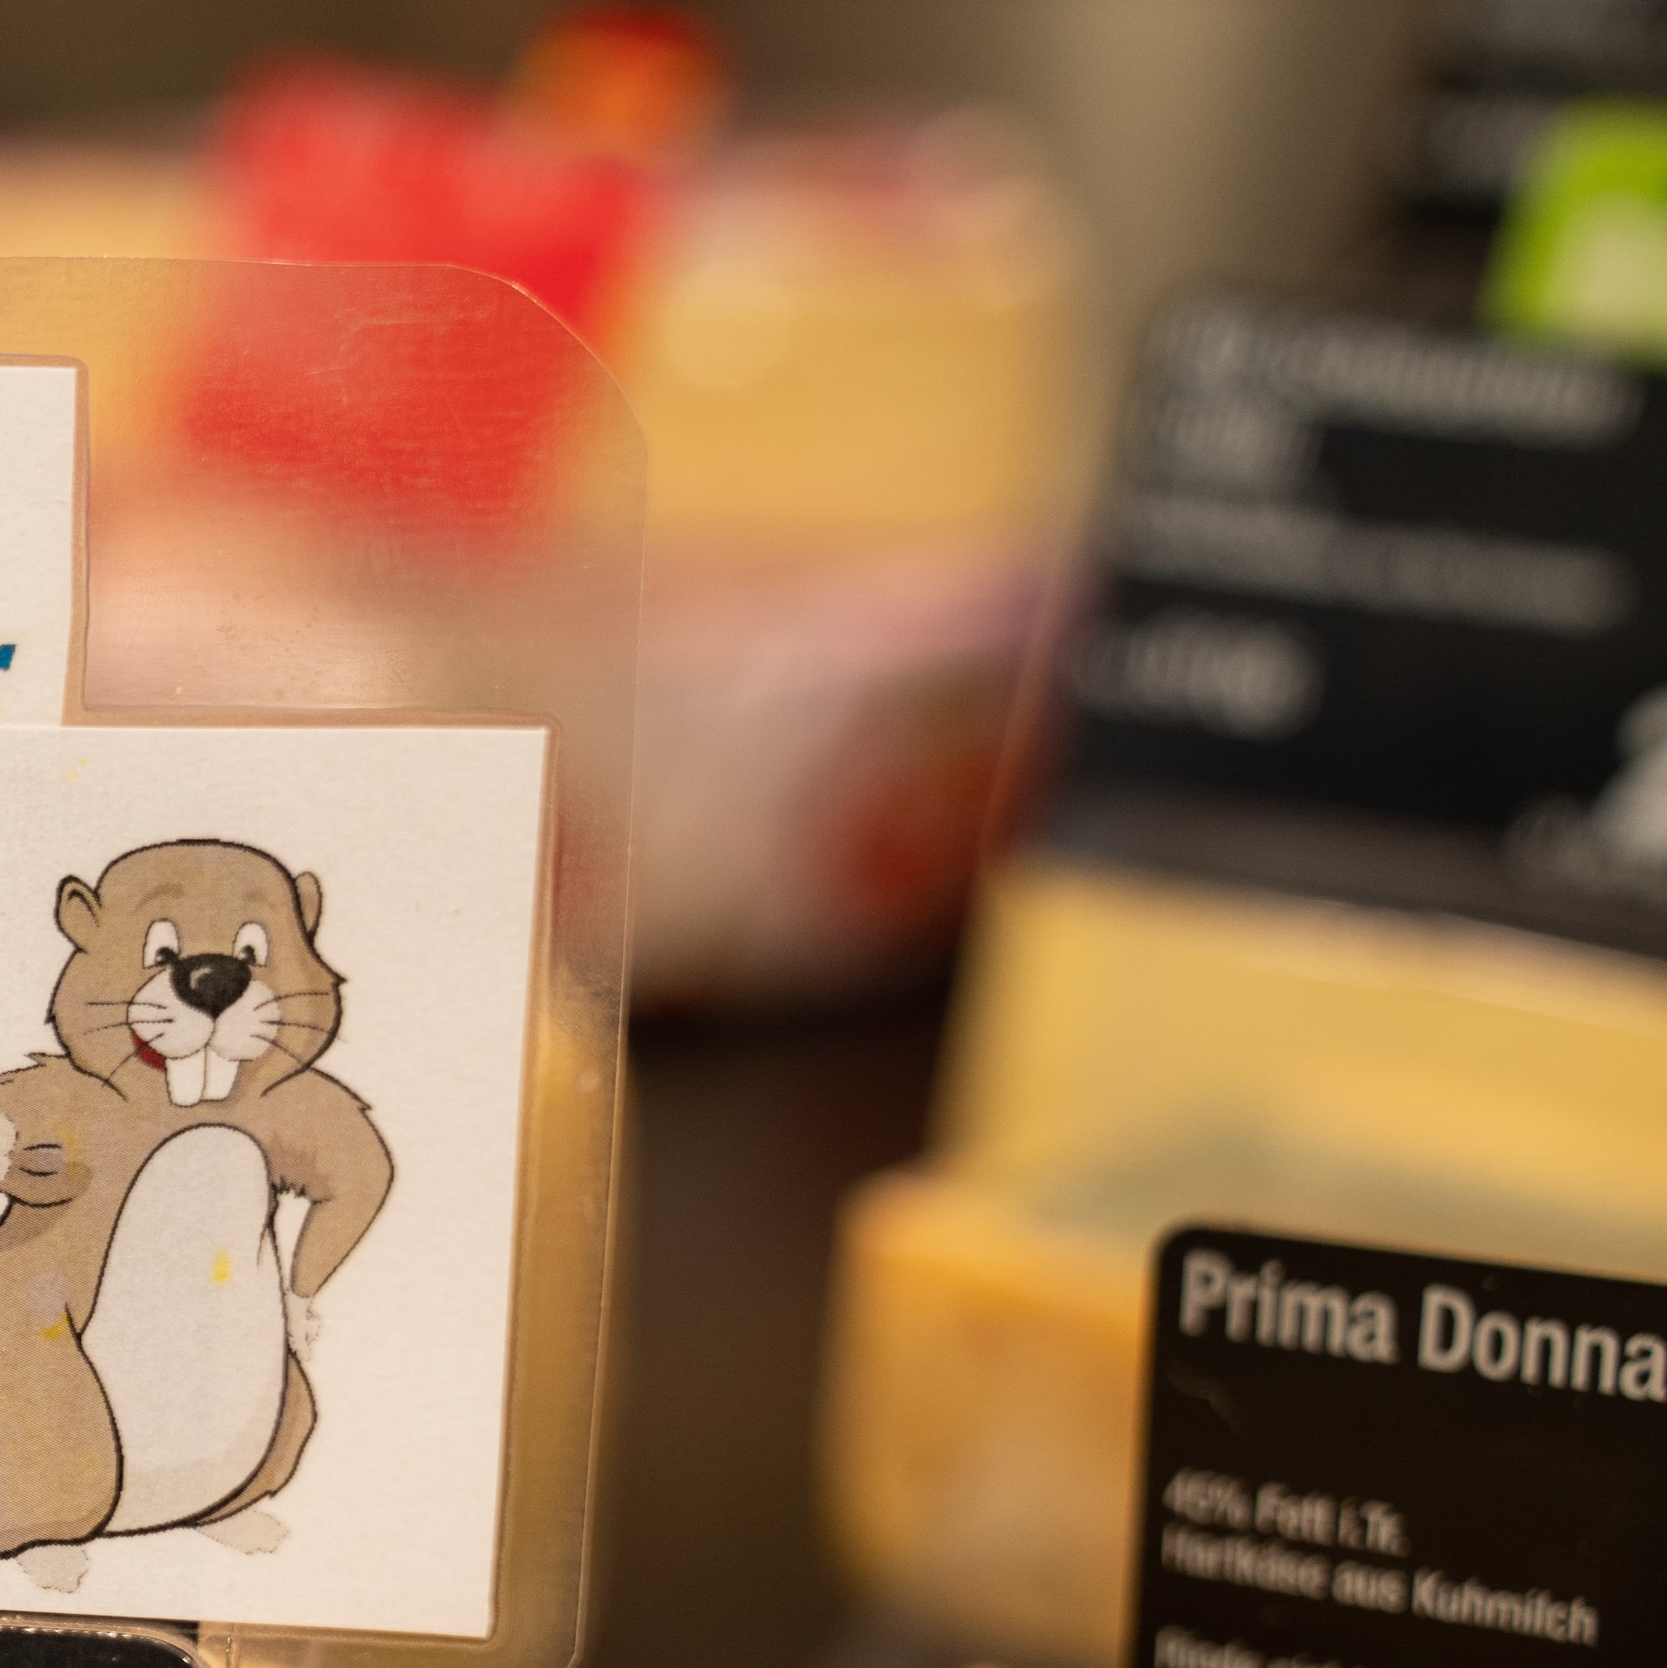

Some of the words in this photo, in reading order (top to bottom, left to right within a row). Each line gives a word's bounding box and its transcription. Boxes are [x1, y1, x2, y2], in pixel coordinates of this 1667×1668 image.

[1178, 1246, 1400, 1366] Prima
[1416, 1281, 1667, 1404] Donna
[1255, 1480, 1336, 1547] Fett
[1331, 1560, 1410, 1614] aus
[1411, 1564, 1599, 1647] Kuhmilch
